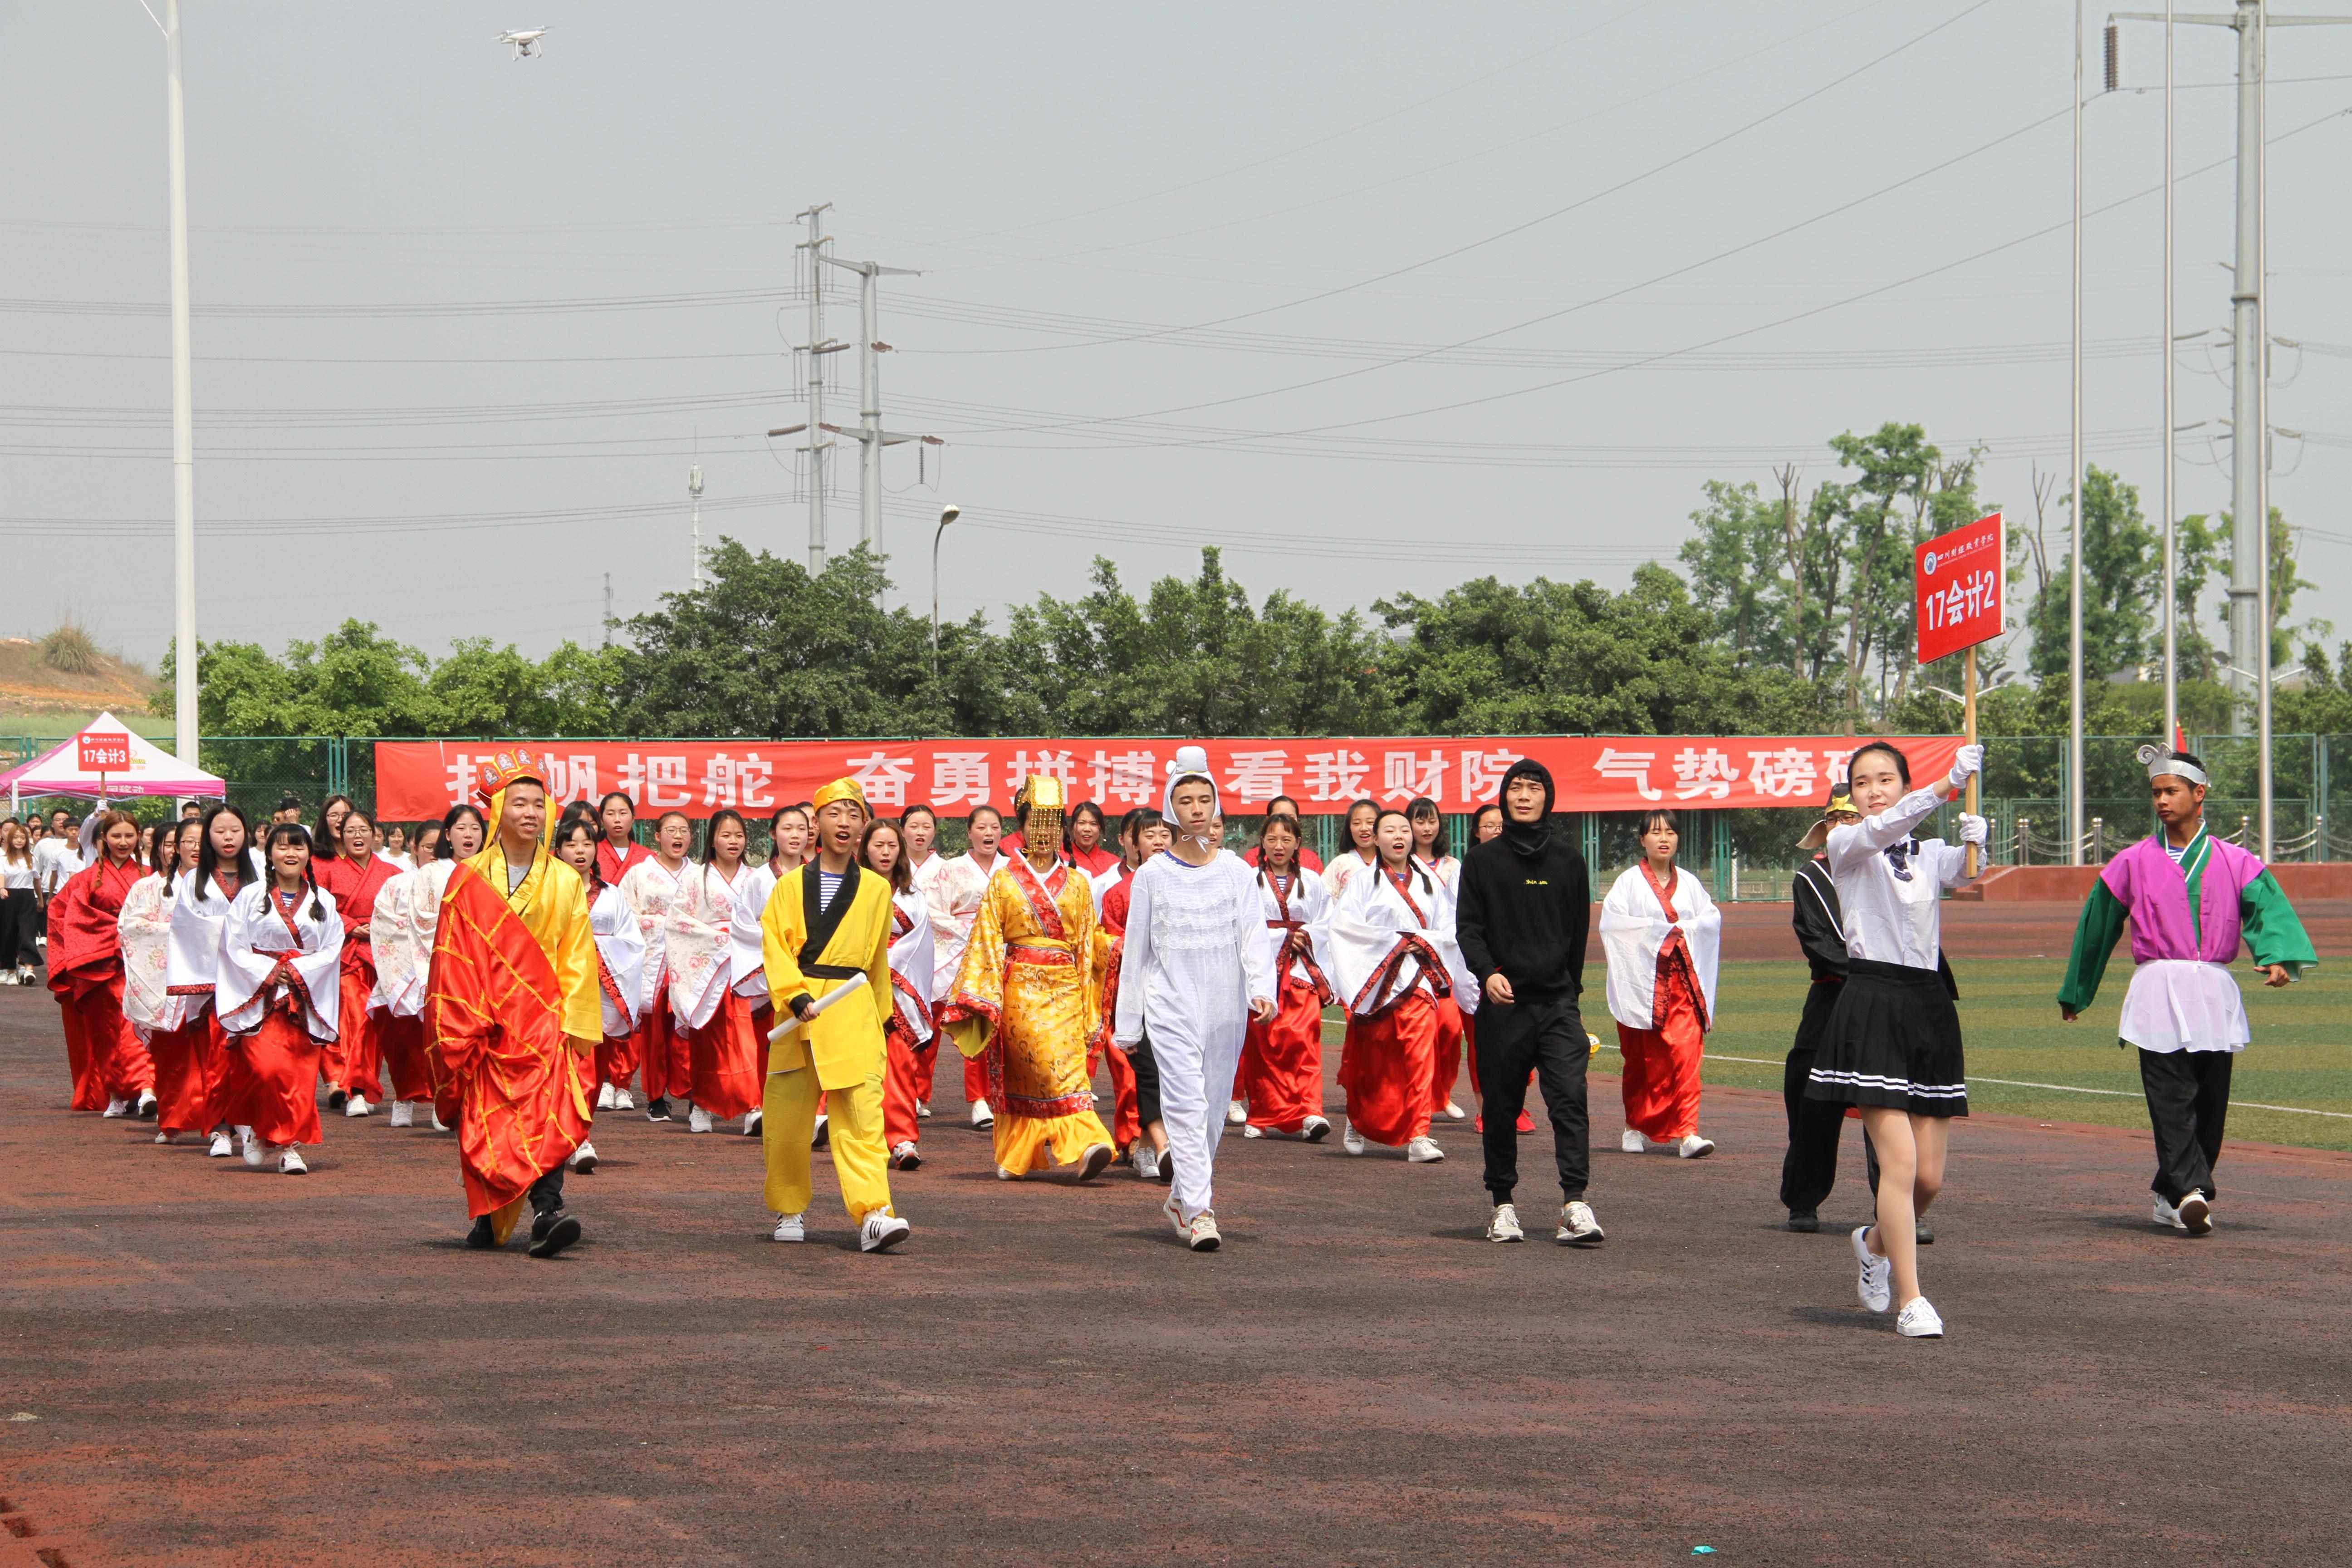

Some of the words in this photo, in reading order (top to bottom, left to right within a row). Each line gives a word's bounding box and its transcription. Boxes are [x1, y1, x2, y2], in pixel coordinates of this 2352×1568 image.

[1926, 570, 1994, 631] 17会计2
[83, 748, 126, 764] 17会计3
[847, 750, 1156, 806] 奋勇拼搏
[1225, 749, 1524, 804] 看我财院
